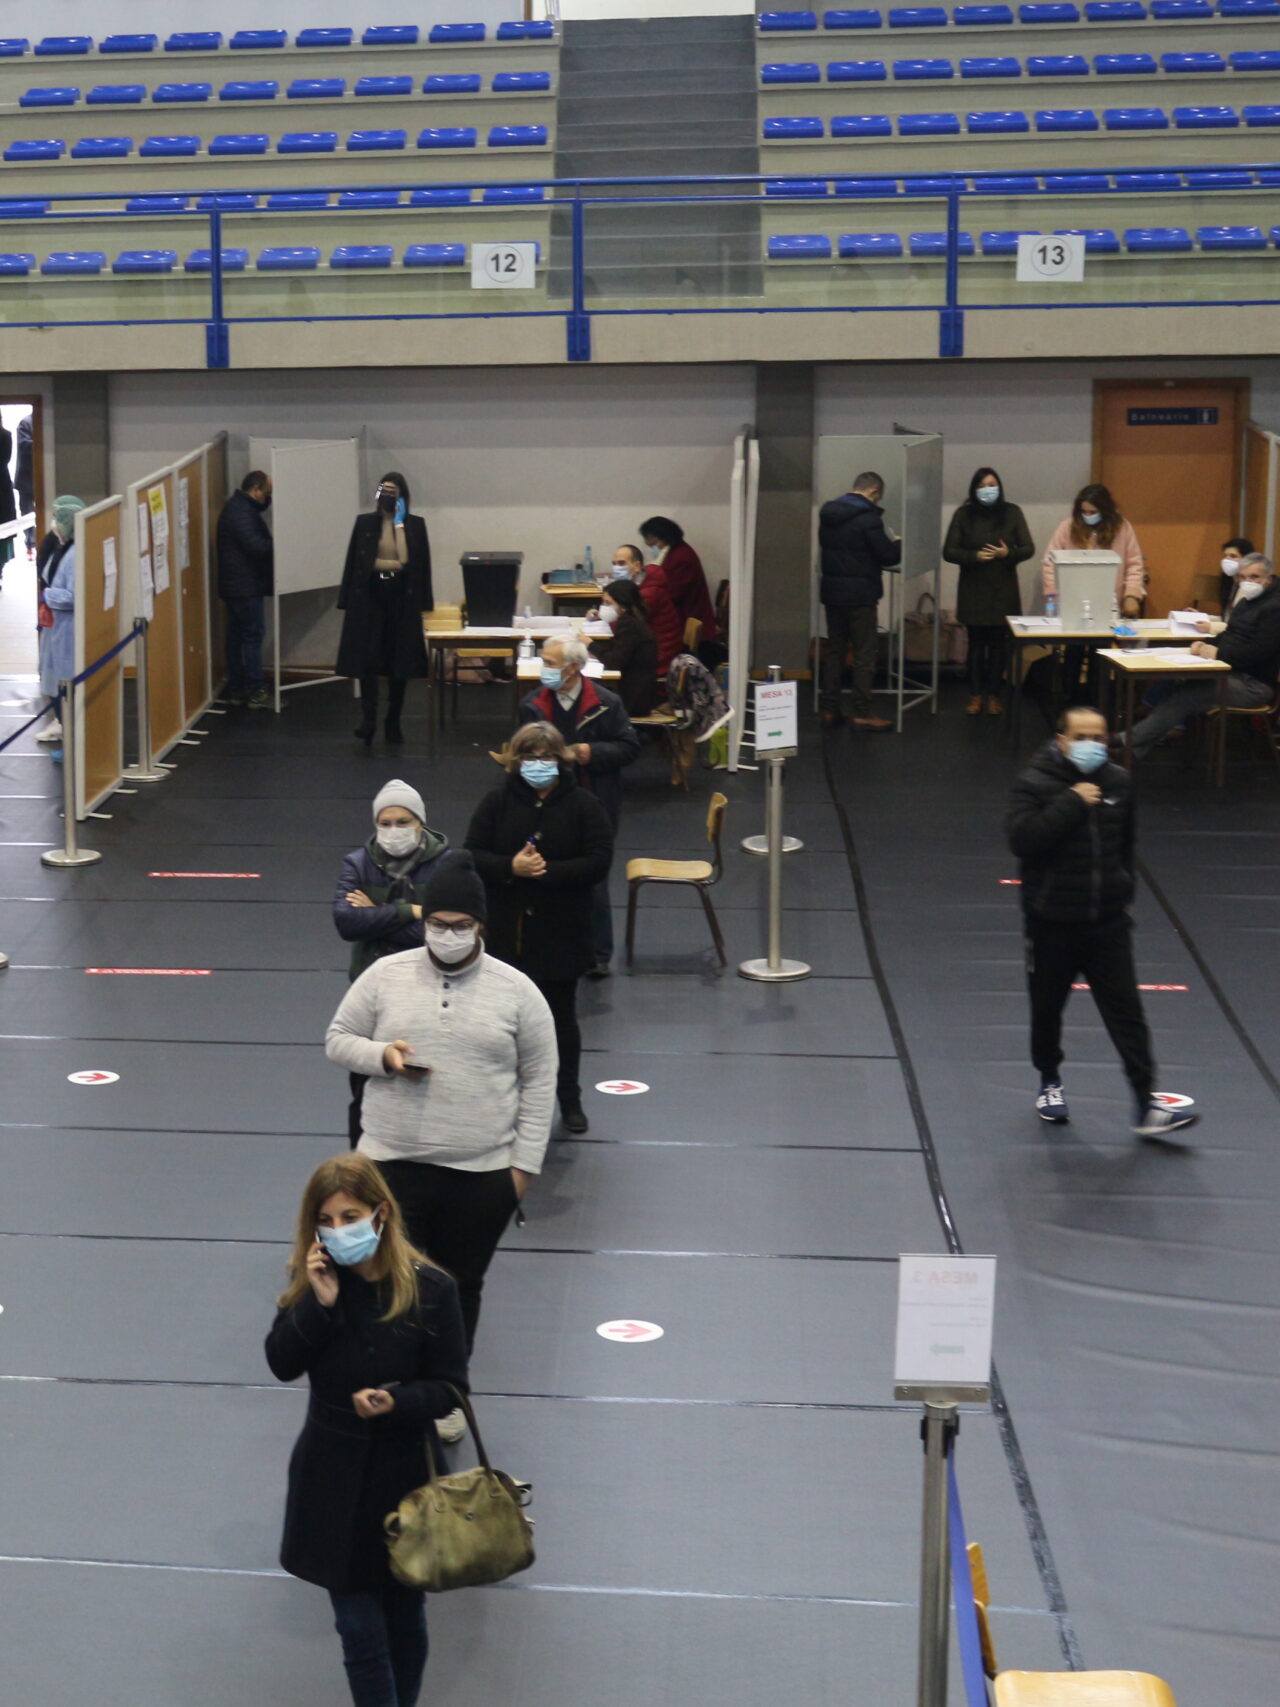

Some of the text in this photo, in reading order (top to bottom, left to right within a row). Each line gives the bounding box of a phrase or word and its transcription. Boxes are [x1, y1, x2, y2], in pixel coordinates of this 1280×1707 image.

[490, 253, 517, 273] 12
[1037, 244, 1065, 266] 13
[761, 690, 783, 699] MESA
